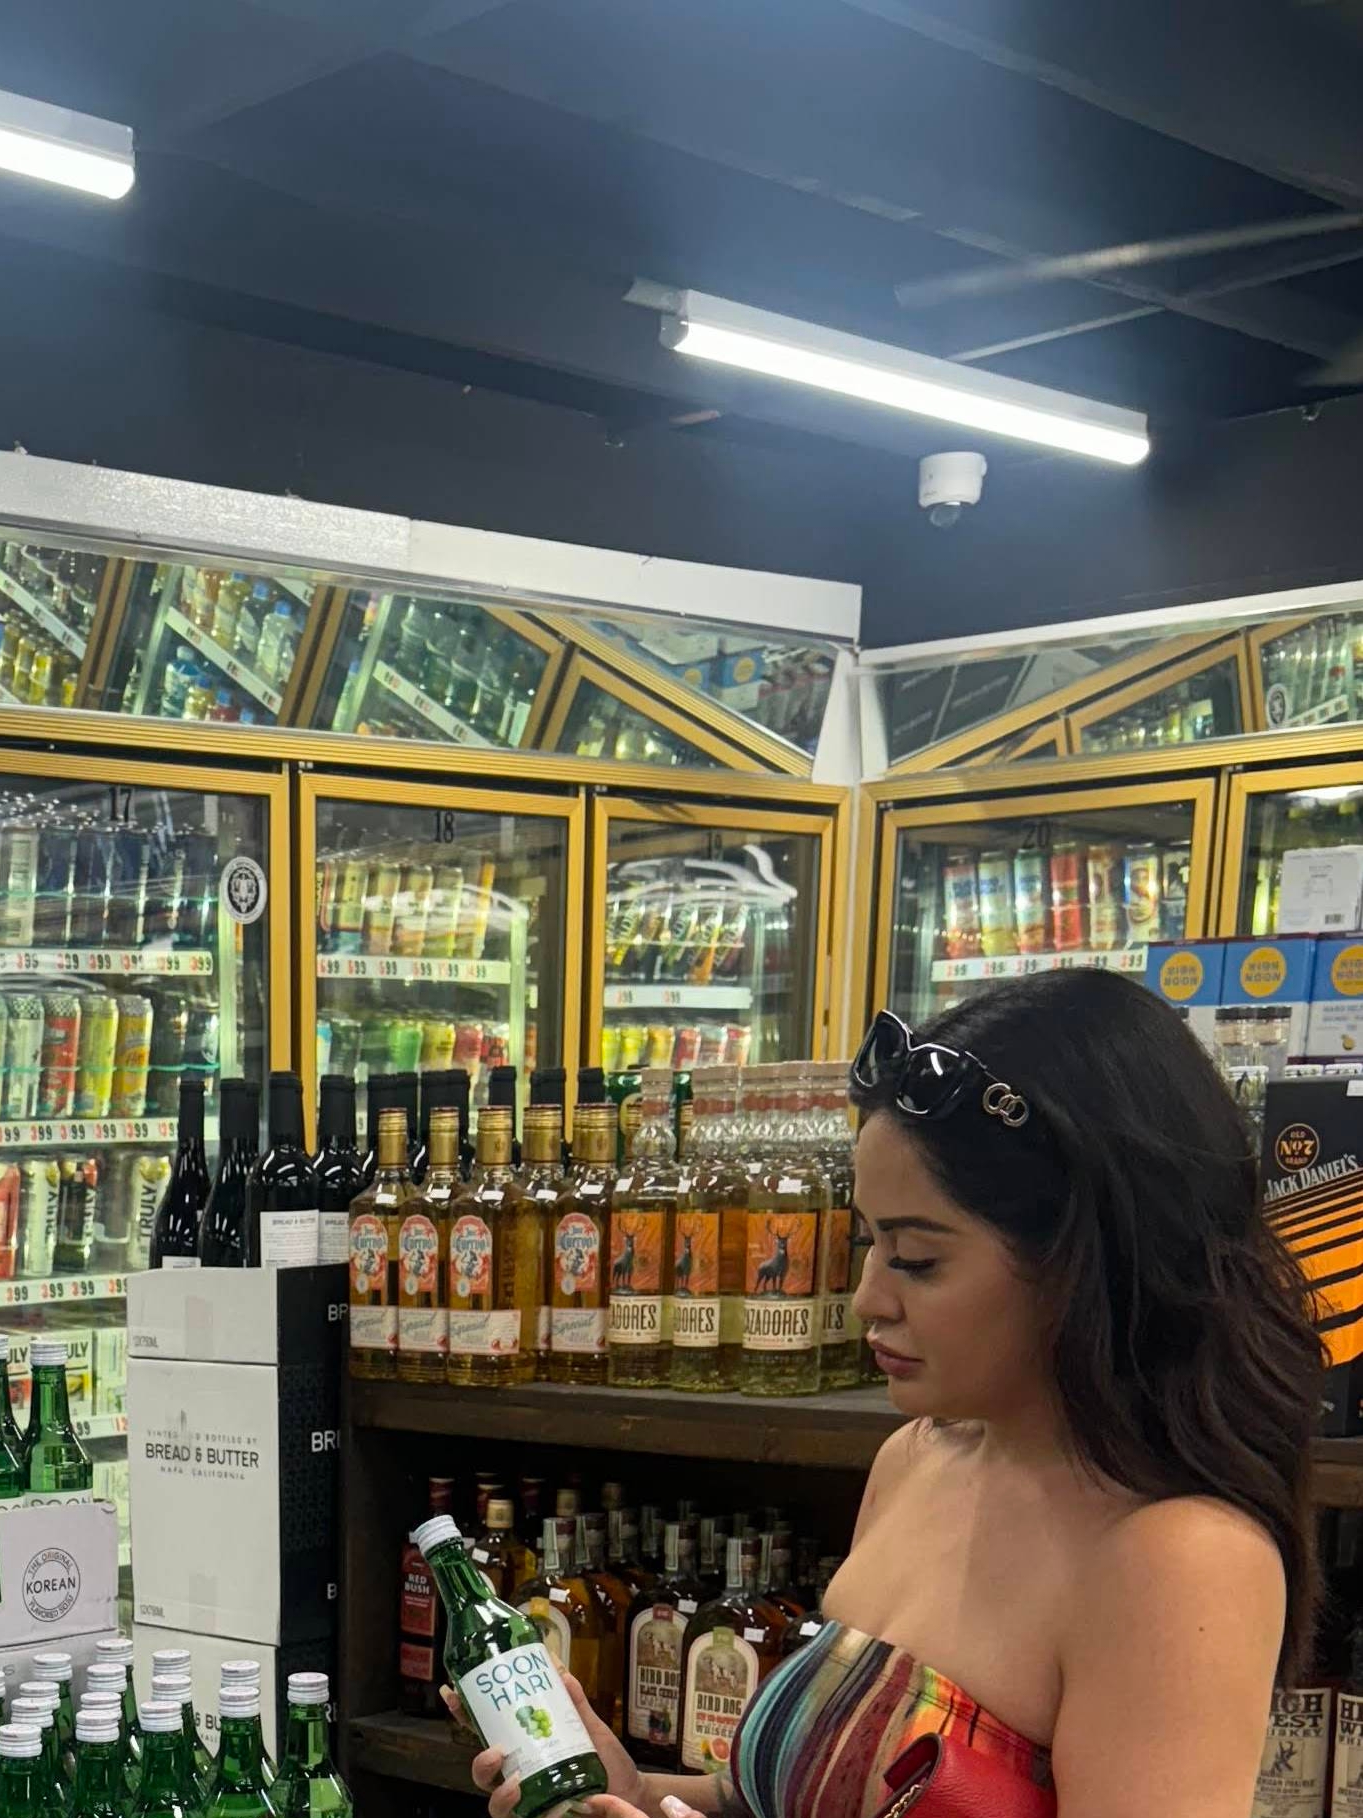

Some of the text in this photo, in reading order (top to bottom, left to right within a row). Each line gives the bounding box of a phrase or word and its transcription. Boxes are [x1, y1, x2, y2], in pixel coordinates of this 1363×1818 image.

[108, 787, 133, 822] 17
[436, 812, 455, 843] 18
[1264, 1174, 1298, 1201] JACK
[146, 1443, 259, 1468] BREAD BUTTER
[26, 1578, 75, 1595] KOREAN
[405, 1583, 430, 1594] BUSH
[477, 1652, 549, 1694] SOON
[491, 1671, 552, 1711] HARI
[697, 1695, 722, 1711] BIRD
